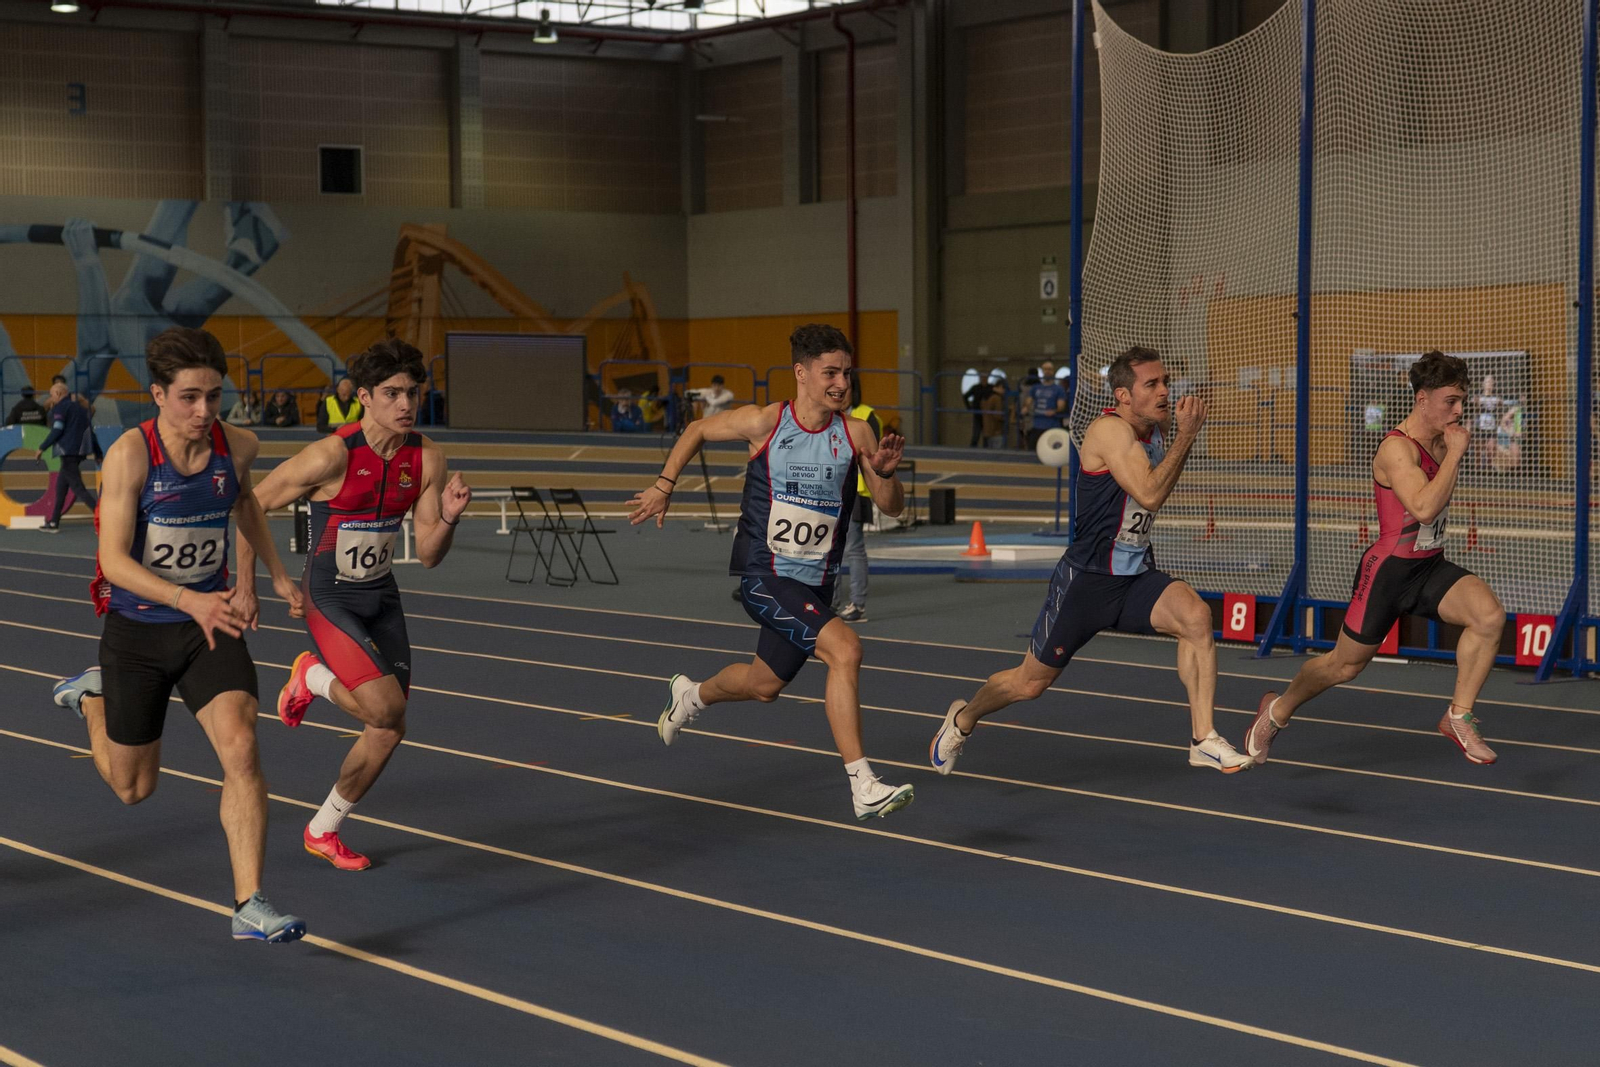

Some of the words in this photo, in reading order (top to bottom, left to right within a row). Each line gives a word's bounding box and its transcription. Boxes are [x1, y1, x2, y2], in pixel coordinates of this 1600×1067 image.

[776, 493, 819, 506] OURENSE
[152, 514, 203, 524] OURENSE
[772, 518, 829, 546] 209
[150, 539, 217, 570] 282
[344, 541, 389, 570] 166
[1230, 602, 1247, 631] 8
[1521, 623, 1552, 657] 10
